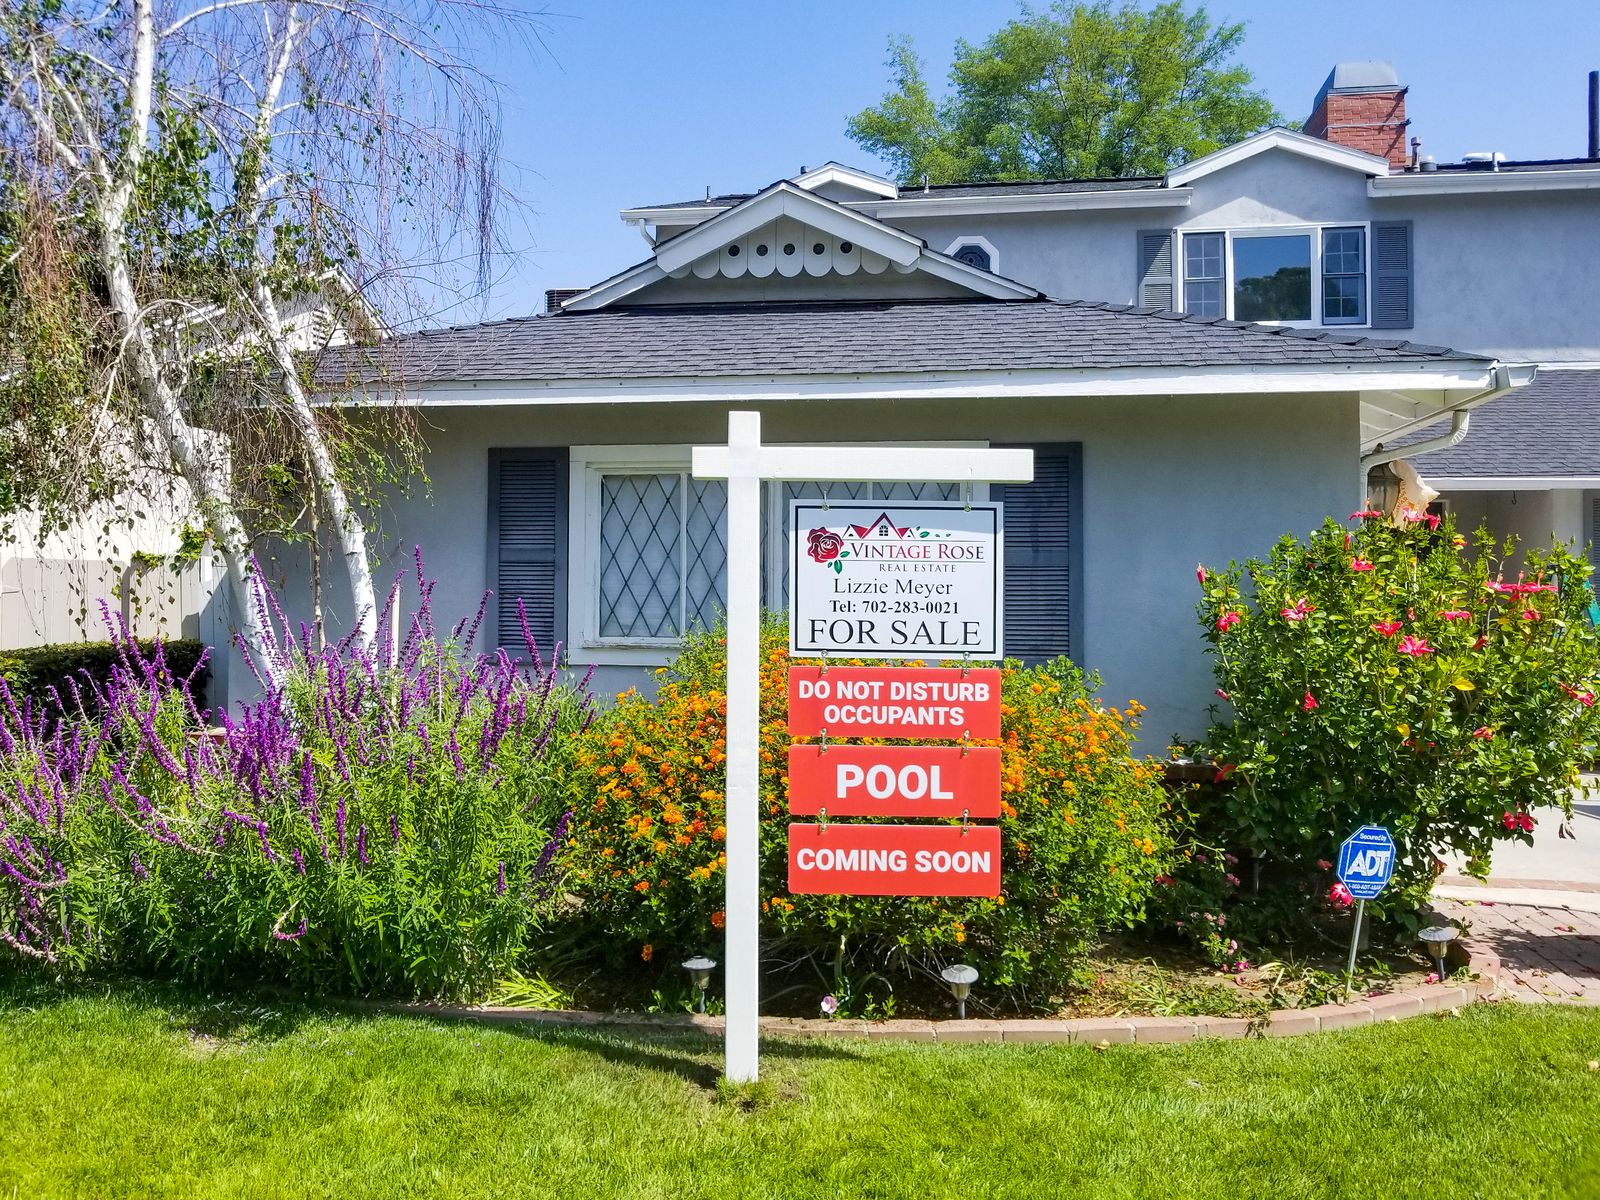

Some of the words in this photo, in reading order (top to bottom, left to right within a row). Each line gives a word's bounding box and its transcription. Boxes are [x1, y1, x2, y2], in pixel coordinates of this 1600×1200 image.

[850, 542, 932, 560] VINTAGE
[938, 543, 984, 560] ROSE
[879, 563, 908, 572] REAL
[914, 564, 957, 573] ESTATE
[834, 577, 889, 594] Lizzie
[895, 578, 953, 599] Meyer
[829, 600, 857, 613] Tel:
[862, 600, 959, 615] 702-283-0021
[808, 619, 880, 644] FOR
[891, 620, 982, 646] SALE
[799, 680, 831, 699] DO
[837, 681, 884, 701] NOT
[890, 682, 990, 702] DISTURB
[824, 705, 965, 726] OCCUPANTS
[836, 764, 954, 800] POOL
[1360, 832, 1380, 841] Secured
[797, 848, 907, 872] COMING
[914, 850, 991, 873] SOON
[1347, 850, 1391, 877] ADT
